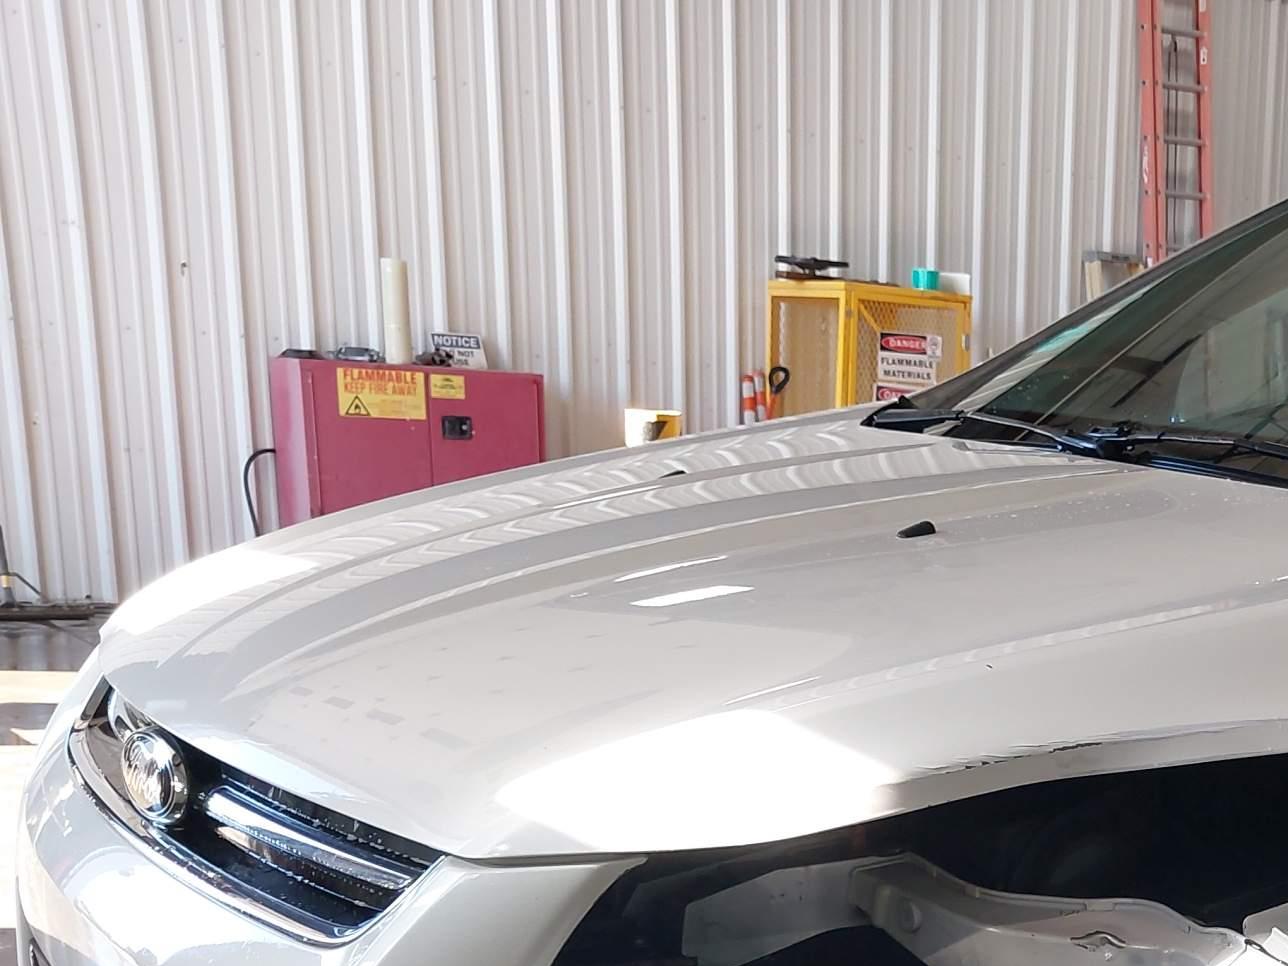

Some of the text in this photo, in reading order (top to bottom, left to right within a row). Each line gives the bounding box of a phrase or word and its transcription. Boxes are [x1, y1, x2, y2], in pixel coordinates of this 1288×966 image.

[433, 335, 478, 347] NOTICE
[457, 350, 474, 358] NOT
[881, 357, 933, 369] FLAMMABLE
[344, 368, 417, 384] FLAMMABLE
[883, 369, 931, 380] MATERIALS
[344, 381, 417, 396] KEEP FIRE AWAY
